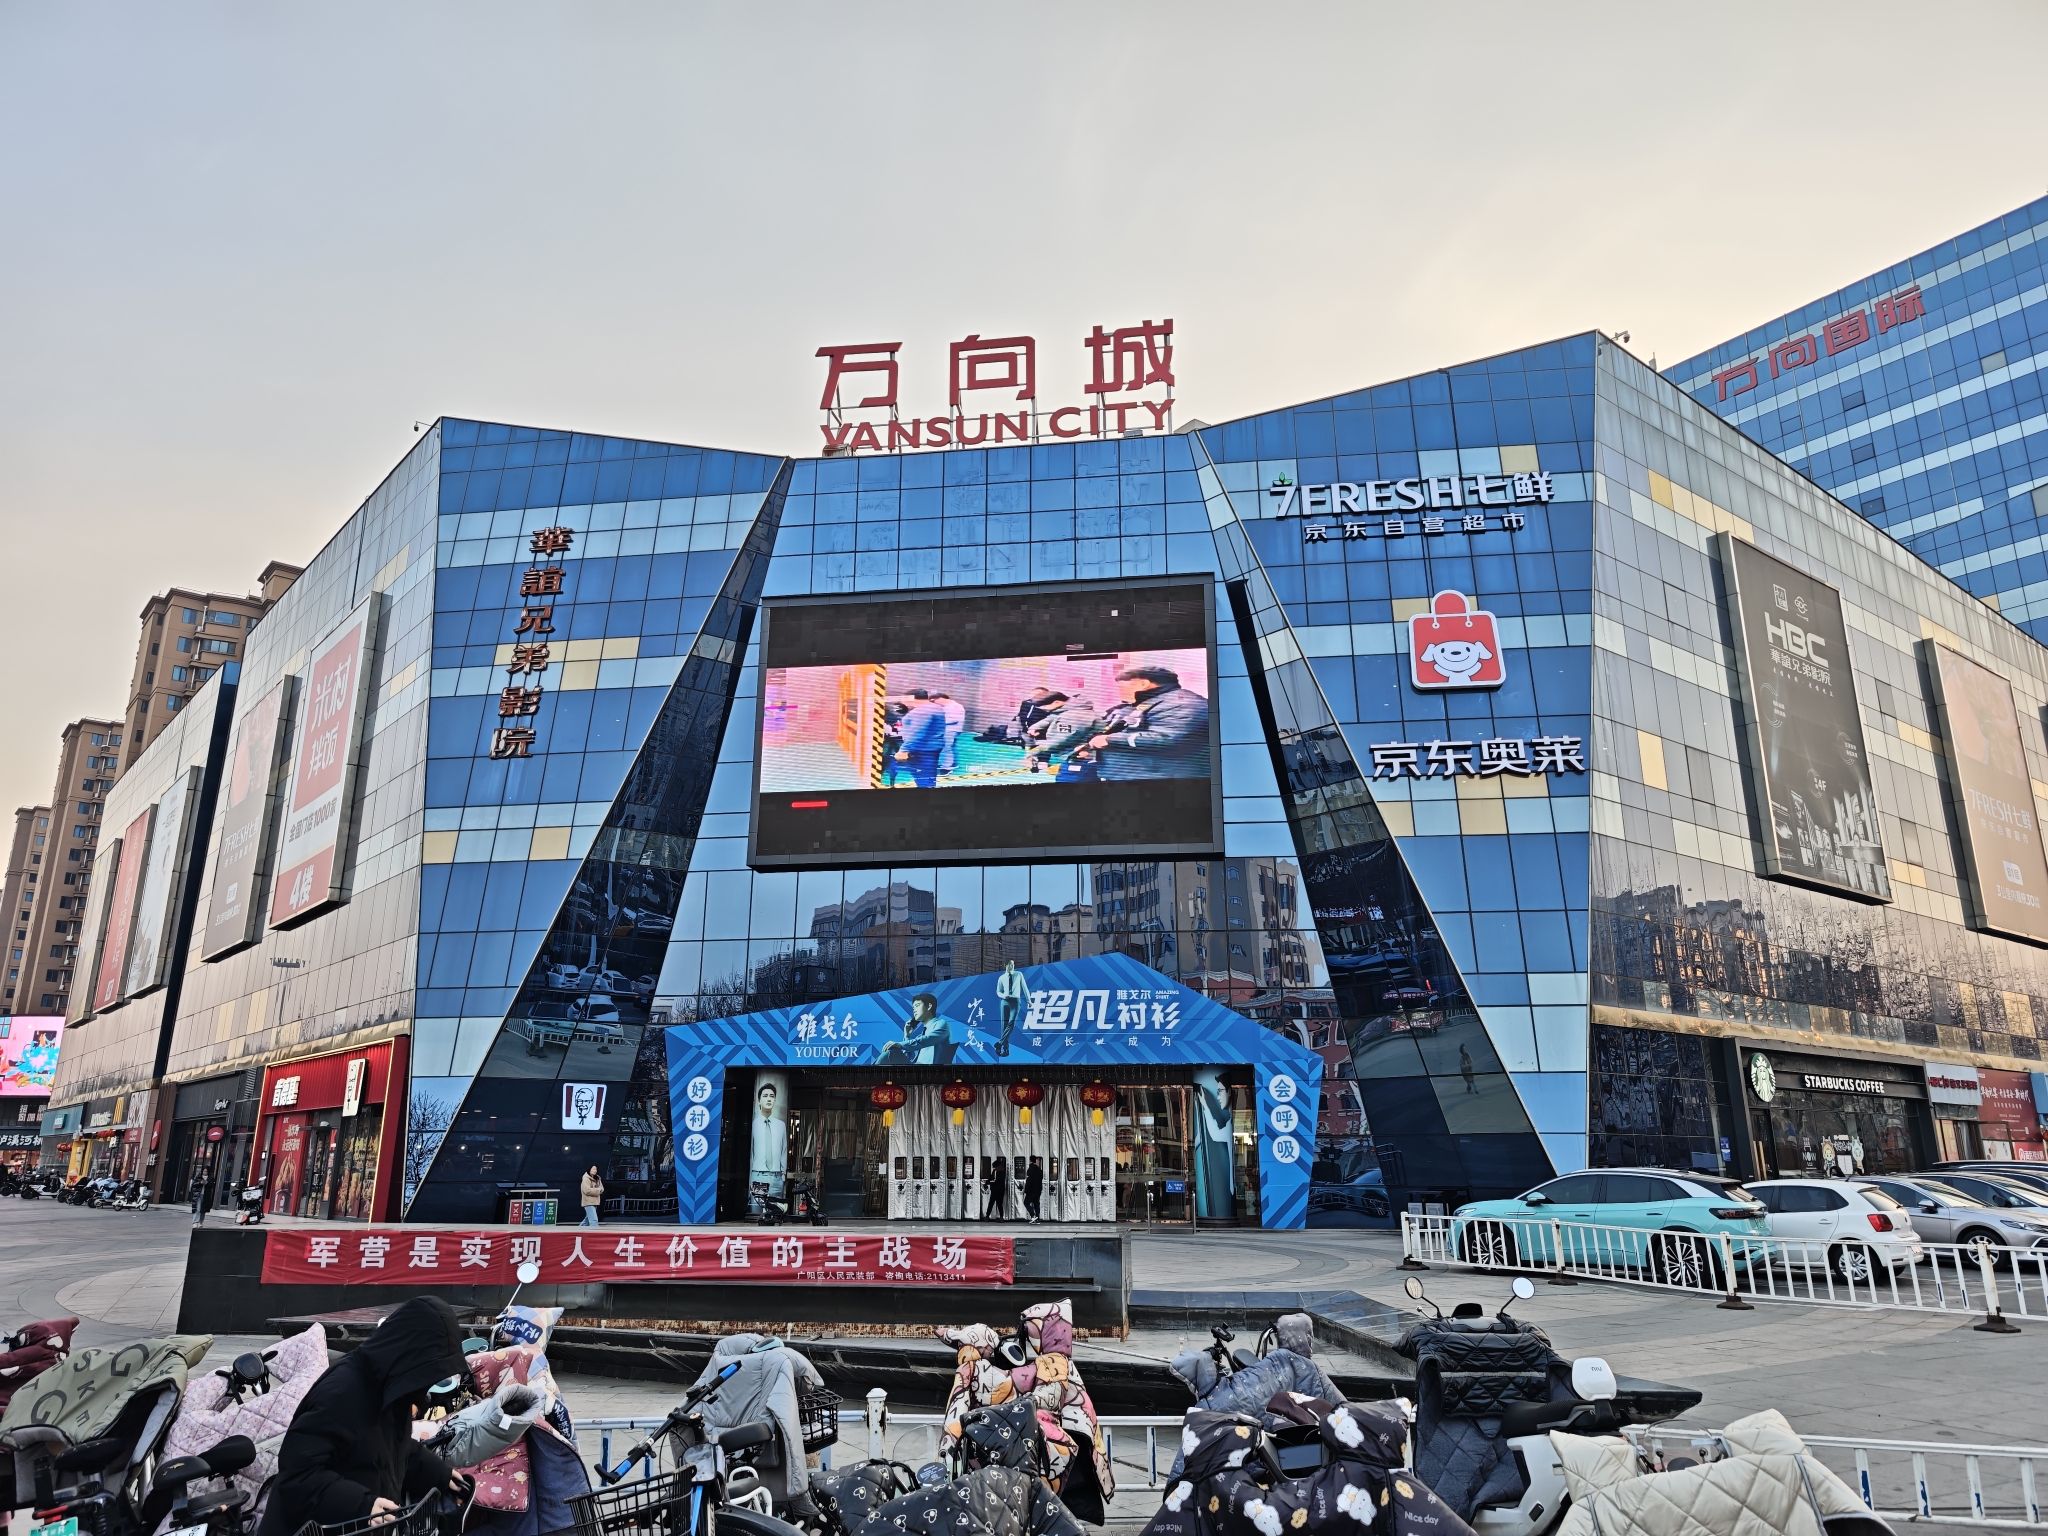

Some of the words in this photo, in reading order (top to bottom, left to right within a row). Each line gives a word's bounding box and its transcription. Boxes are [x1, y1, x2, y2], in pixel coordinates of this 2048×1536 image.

[815, 319, 1174, 409] 万向城
[1711, 285, 1926, 401] 万向国际
[820, 411, 1028, 452] VANSUN
[1050, 399, 1175, 438] CITY
[1305, 513, 1525, 541] 京东自营超市
[489, 527, 575, 759] 華誼兄弟影院
[1764, 612, 1829, 668] HBC
[311, 654, 352, 731] 米村
[1370, 735, 1586, 779] 京东奥莱
[289, 863, 314, 911] 4楼
[1117, 989, 1151, 1000] 雅戈尔
[795, 1046, 859, 1058] YOUNGOR
[797, 1013, 858, 1044] 雅戈尔
[1804, 1074, 1855, 1092] STARBUCKS
[1856, 1079, 1884, 1094] COFFEE
[687, 1080, 709, 1155] 好衬衫
[1273, 1078, 1296, 1160] 会呼吸
[307, 1235, 968, 1270] 军营是实现人生价值的主战场
[1404, 1511, 1423, 1523] Nice
[1424, 1515, 1440, 1526] day
